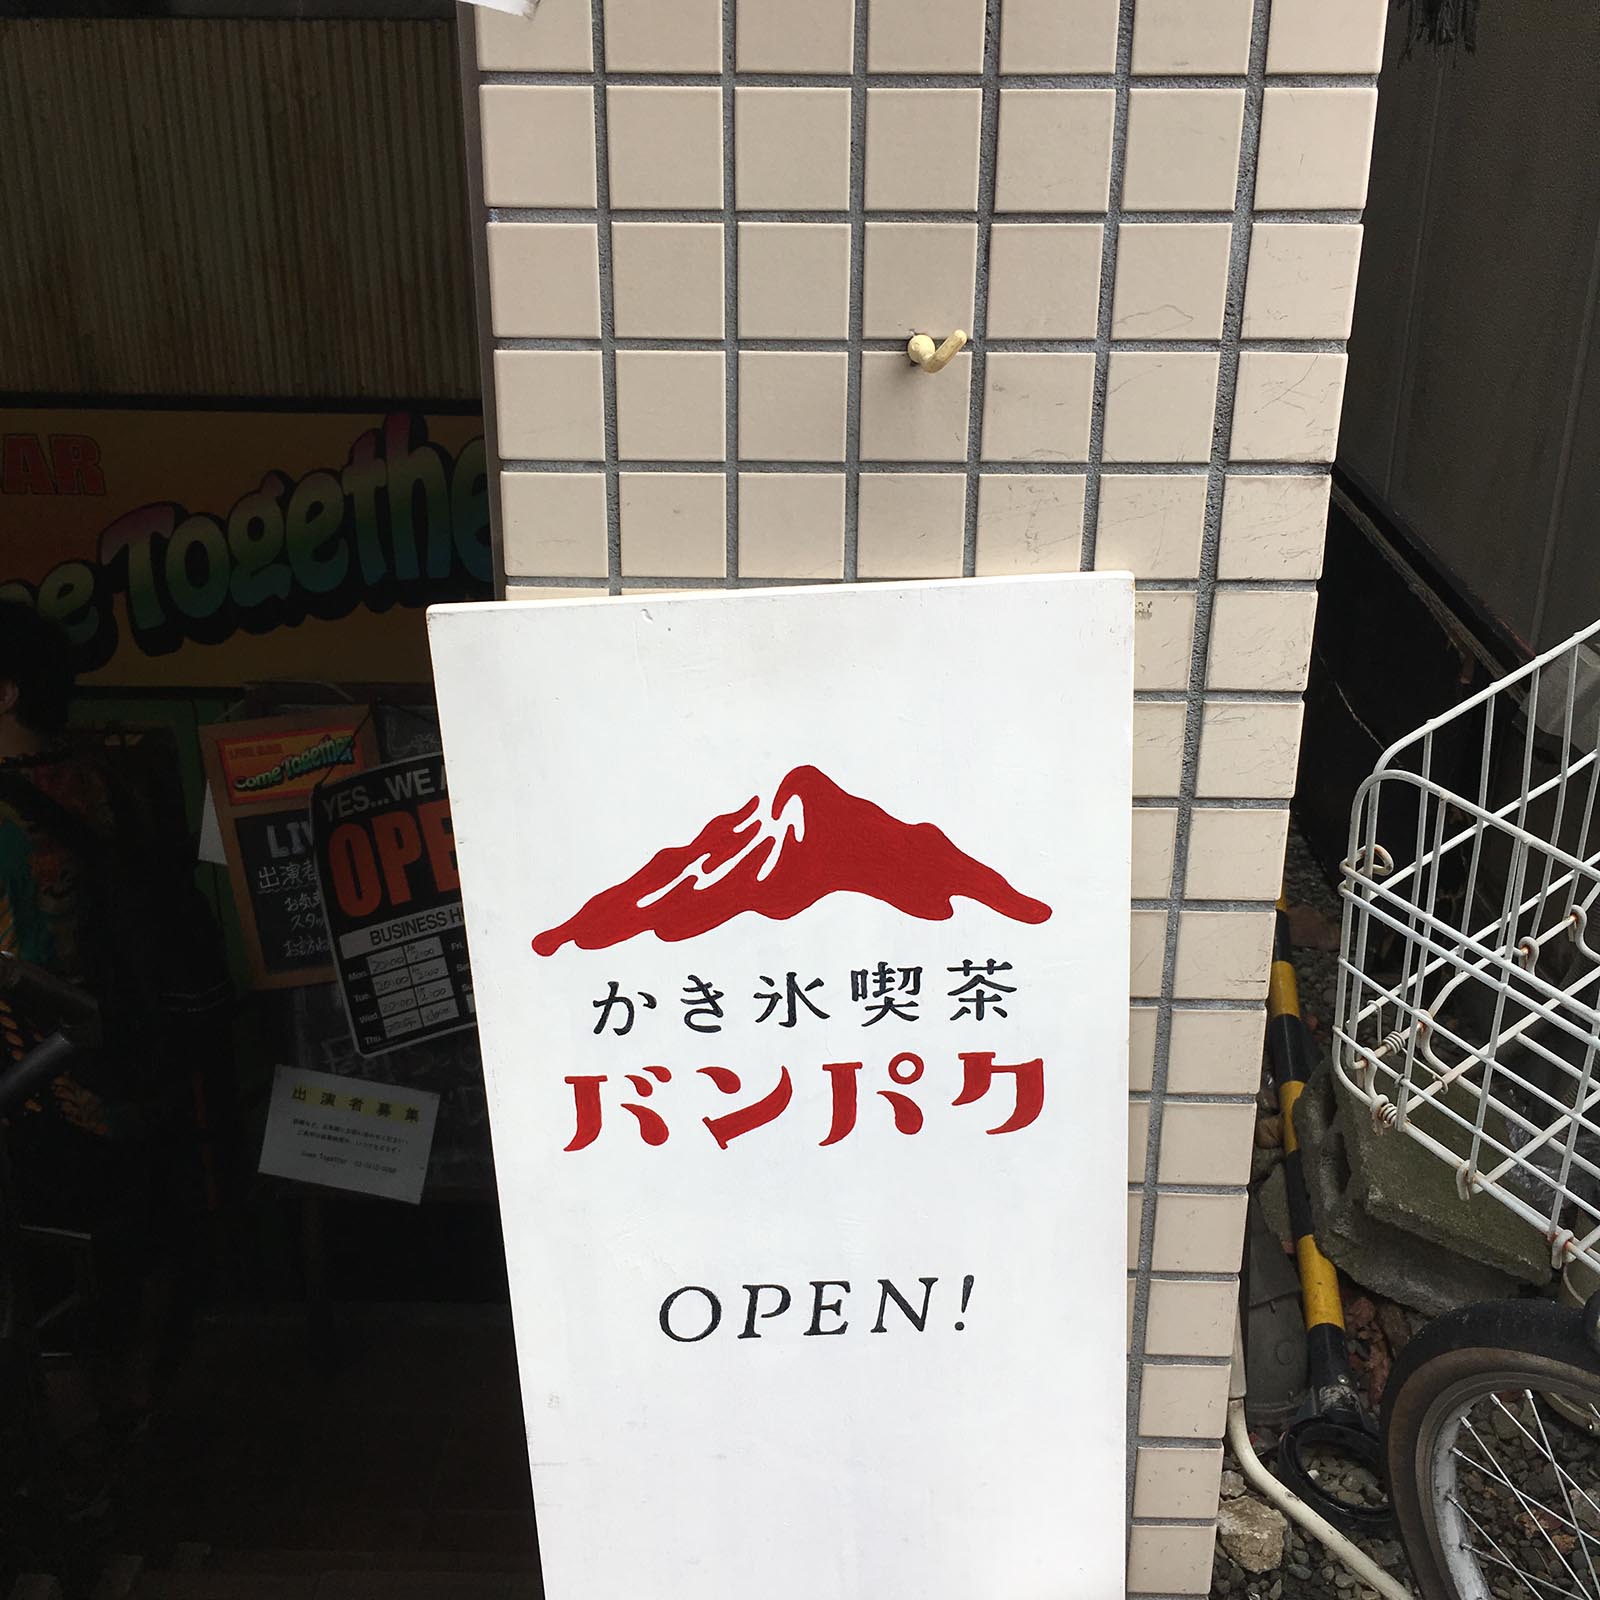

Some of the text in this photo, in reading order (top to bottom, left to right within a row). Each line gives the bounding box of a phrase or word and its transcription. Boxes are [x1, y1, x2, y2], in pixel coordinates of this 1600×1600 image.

[370, 910, 447, 946] BUSINESS
[593, 959, 1017, 1036] かき氷喫茶
[564, 1052, 1045, 1152] バンパク
[659, 1274, 975, 1343] OPEN!
